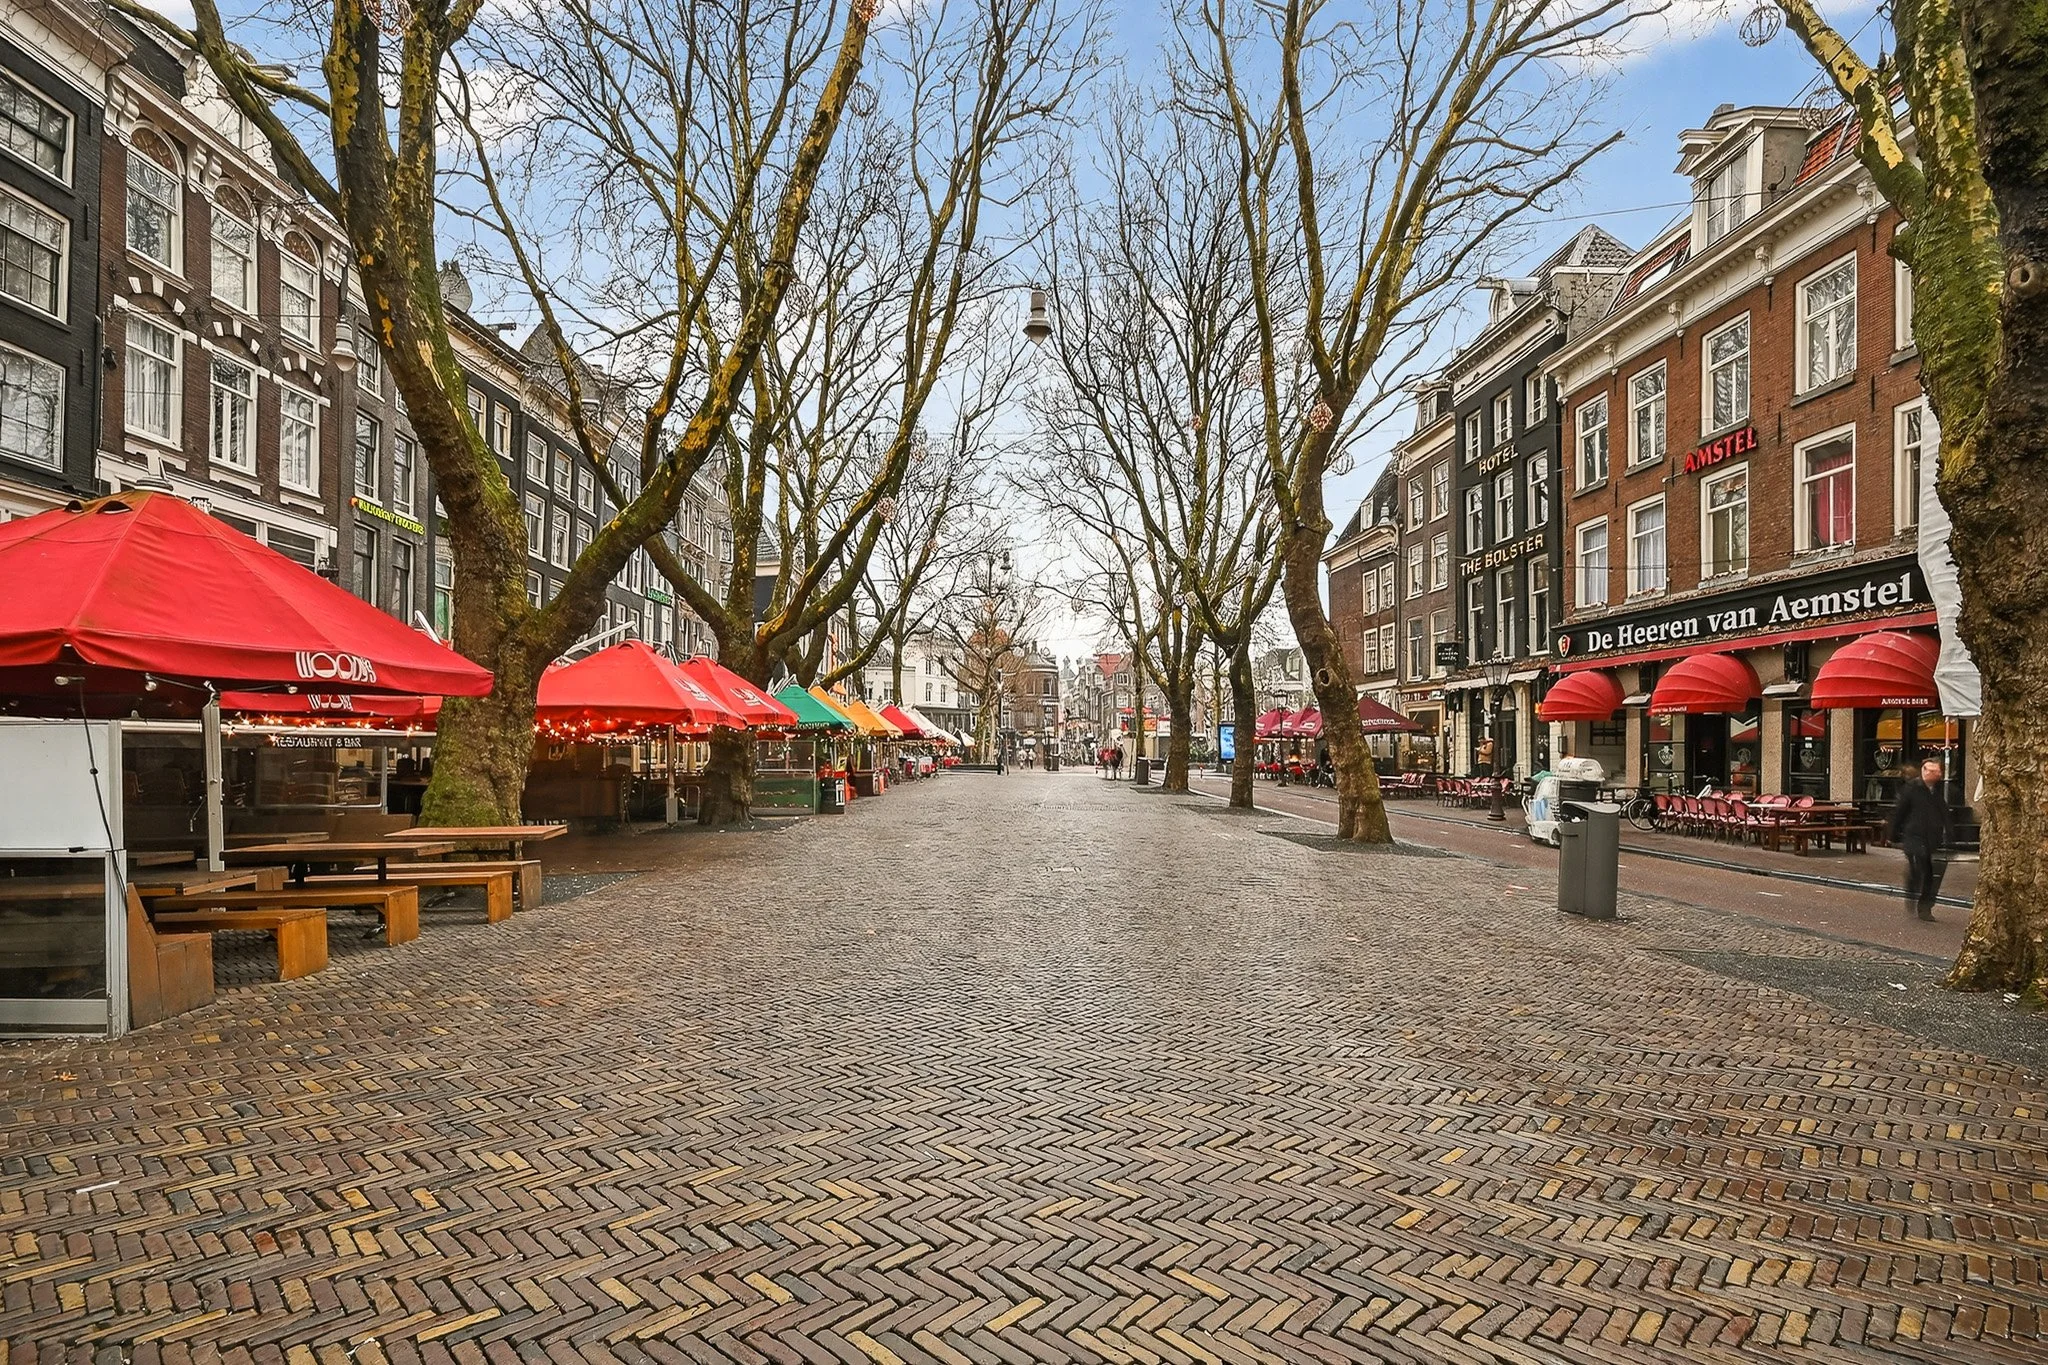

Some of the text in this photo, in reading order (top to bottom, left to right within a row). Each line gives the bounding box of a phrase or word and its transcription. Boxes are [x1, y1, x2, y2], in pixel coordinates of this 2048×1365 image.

[1478, 443, 1519, 476] HOTEL
[1682, 427, 1757, 475] AMSTEL
[1460, 533, 1544, 576] THE BOLSTER
[1588, 572, 1914, 652] De Heeren van Aemstel
